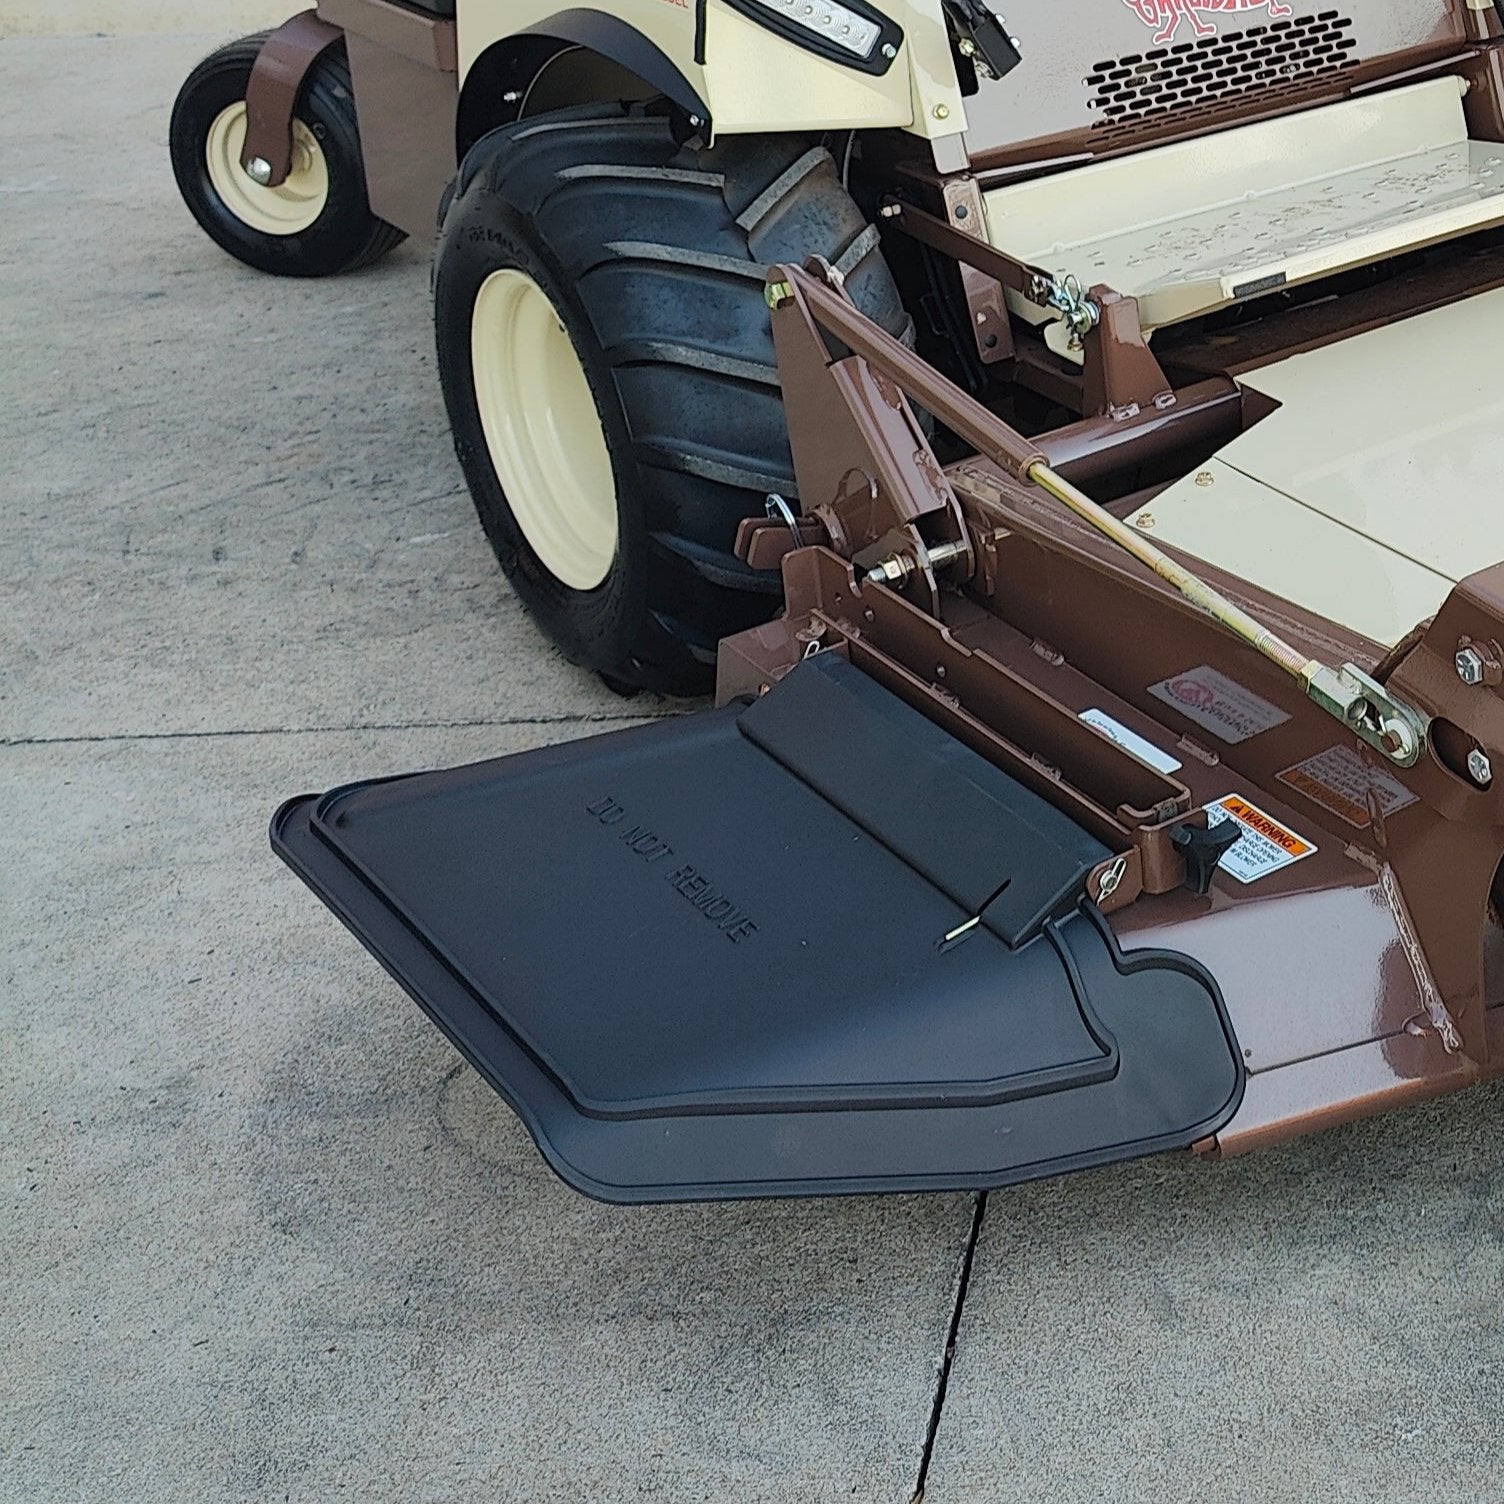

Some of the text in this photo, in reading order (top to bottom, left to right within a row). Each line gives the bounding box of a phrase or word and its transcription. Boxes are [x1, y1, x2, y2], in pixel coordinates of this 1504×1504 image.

[585, 796, 760, 943] DO NOT REMOVE
[1241, 810, 1297, 848] WARNING
